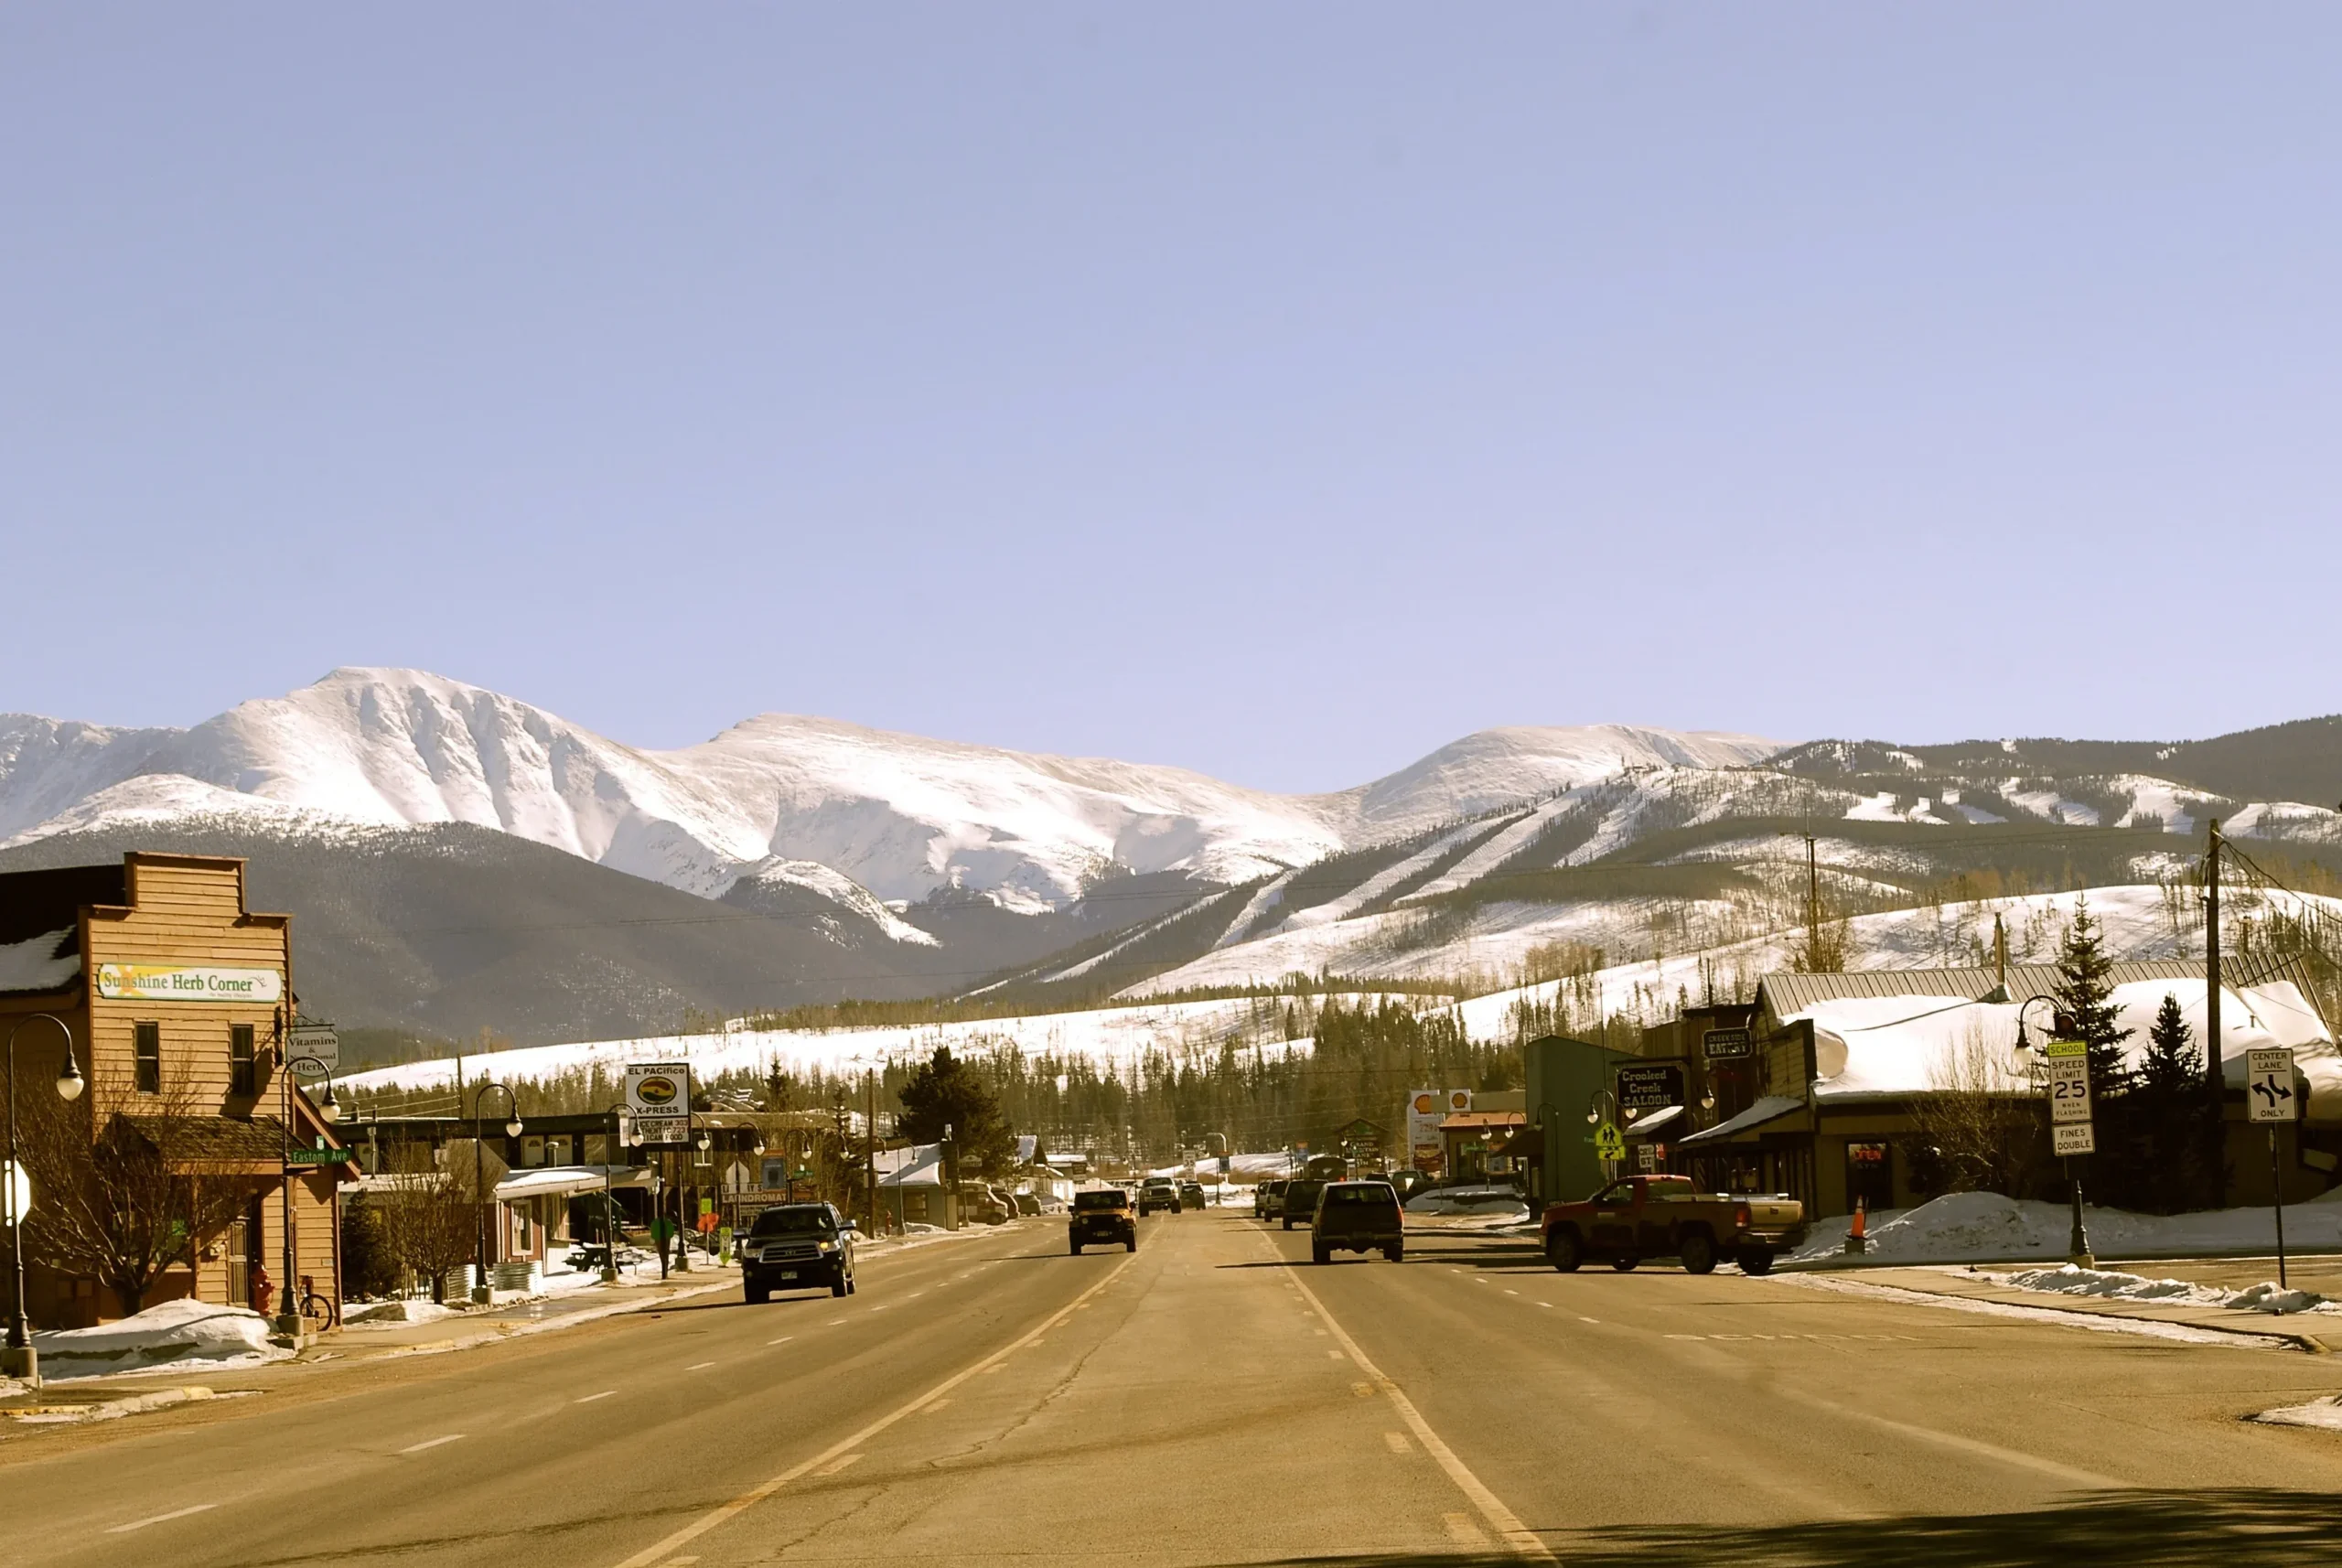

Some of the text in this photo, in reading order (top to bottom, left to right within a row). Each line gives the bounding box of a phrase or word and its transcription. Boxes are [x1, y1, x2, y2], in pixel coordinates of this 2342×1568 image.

[104, 972, 252, 992] Sunshine Herb Corner
[289, 1036, 337, 1047] Vitamins
[2050, 1045, 2085, 1054] SCHOOL
[2252, 1052, 2287, 1060] CENTER
[296, 1062, 329, 1071] Herb
[2052, 1060, 2085, 1069] SPEED
[2258, 1061, 2283, 1069] LANE
[644, 1067, 685, 1075] PACifico
[1622, 1069, 1667, 1081] Crooked
[2057, 1070, 2081, 1079] LIMIT
[1629, 1082, 1661, 1093] Creek
[2054, 1080, 2086, 1099] 25
[1623, 1094, 1672, 1106] SALOON
[636, 1106, 679, 1114] X-PRESS
[2060, 1129, 2086, 1138] FINES
[2057, 1140, 2090, 1150] DOUBLE
[294, 1151, 348, 1163] Eastom Ave
